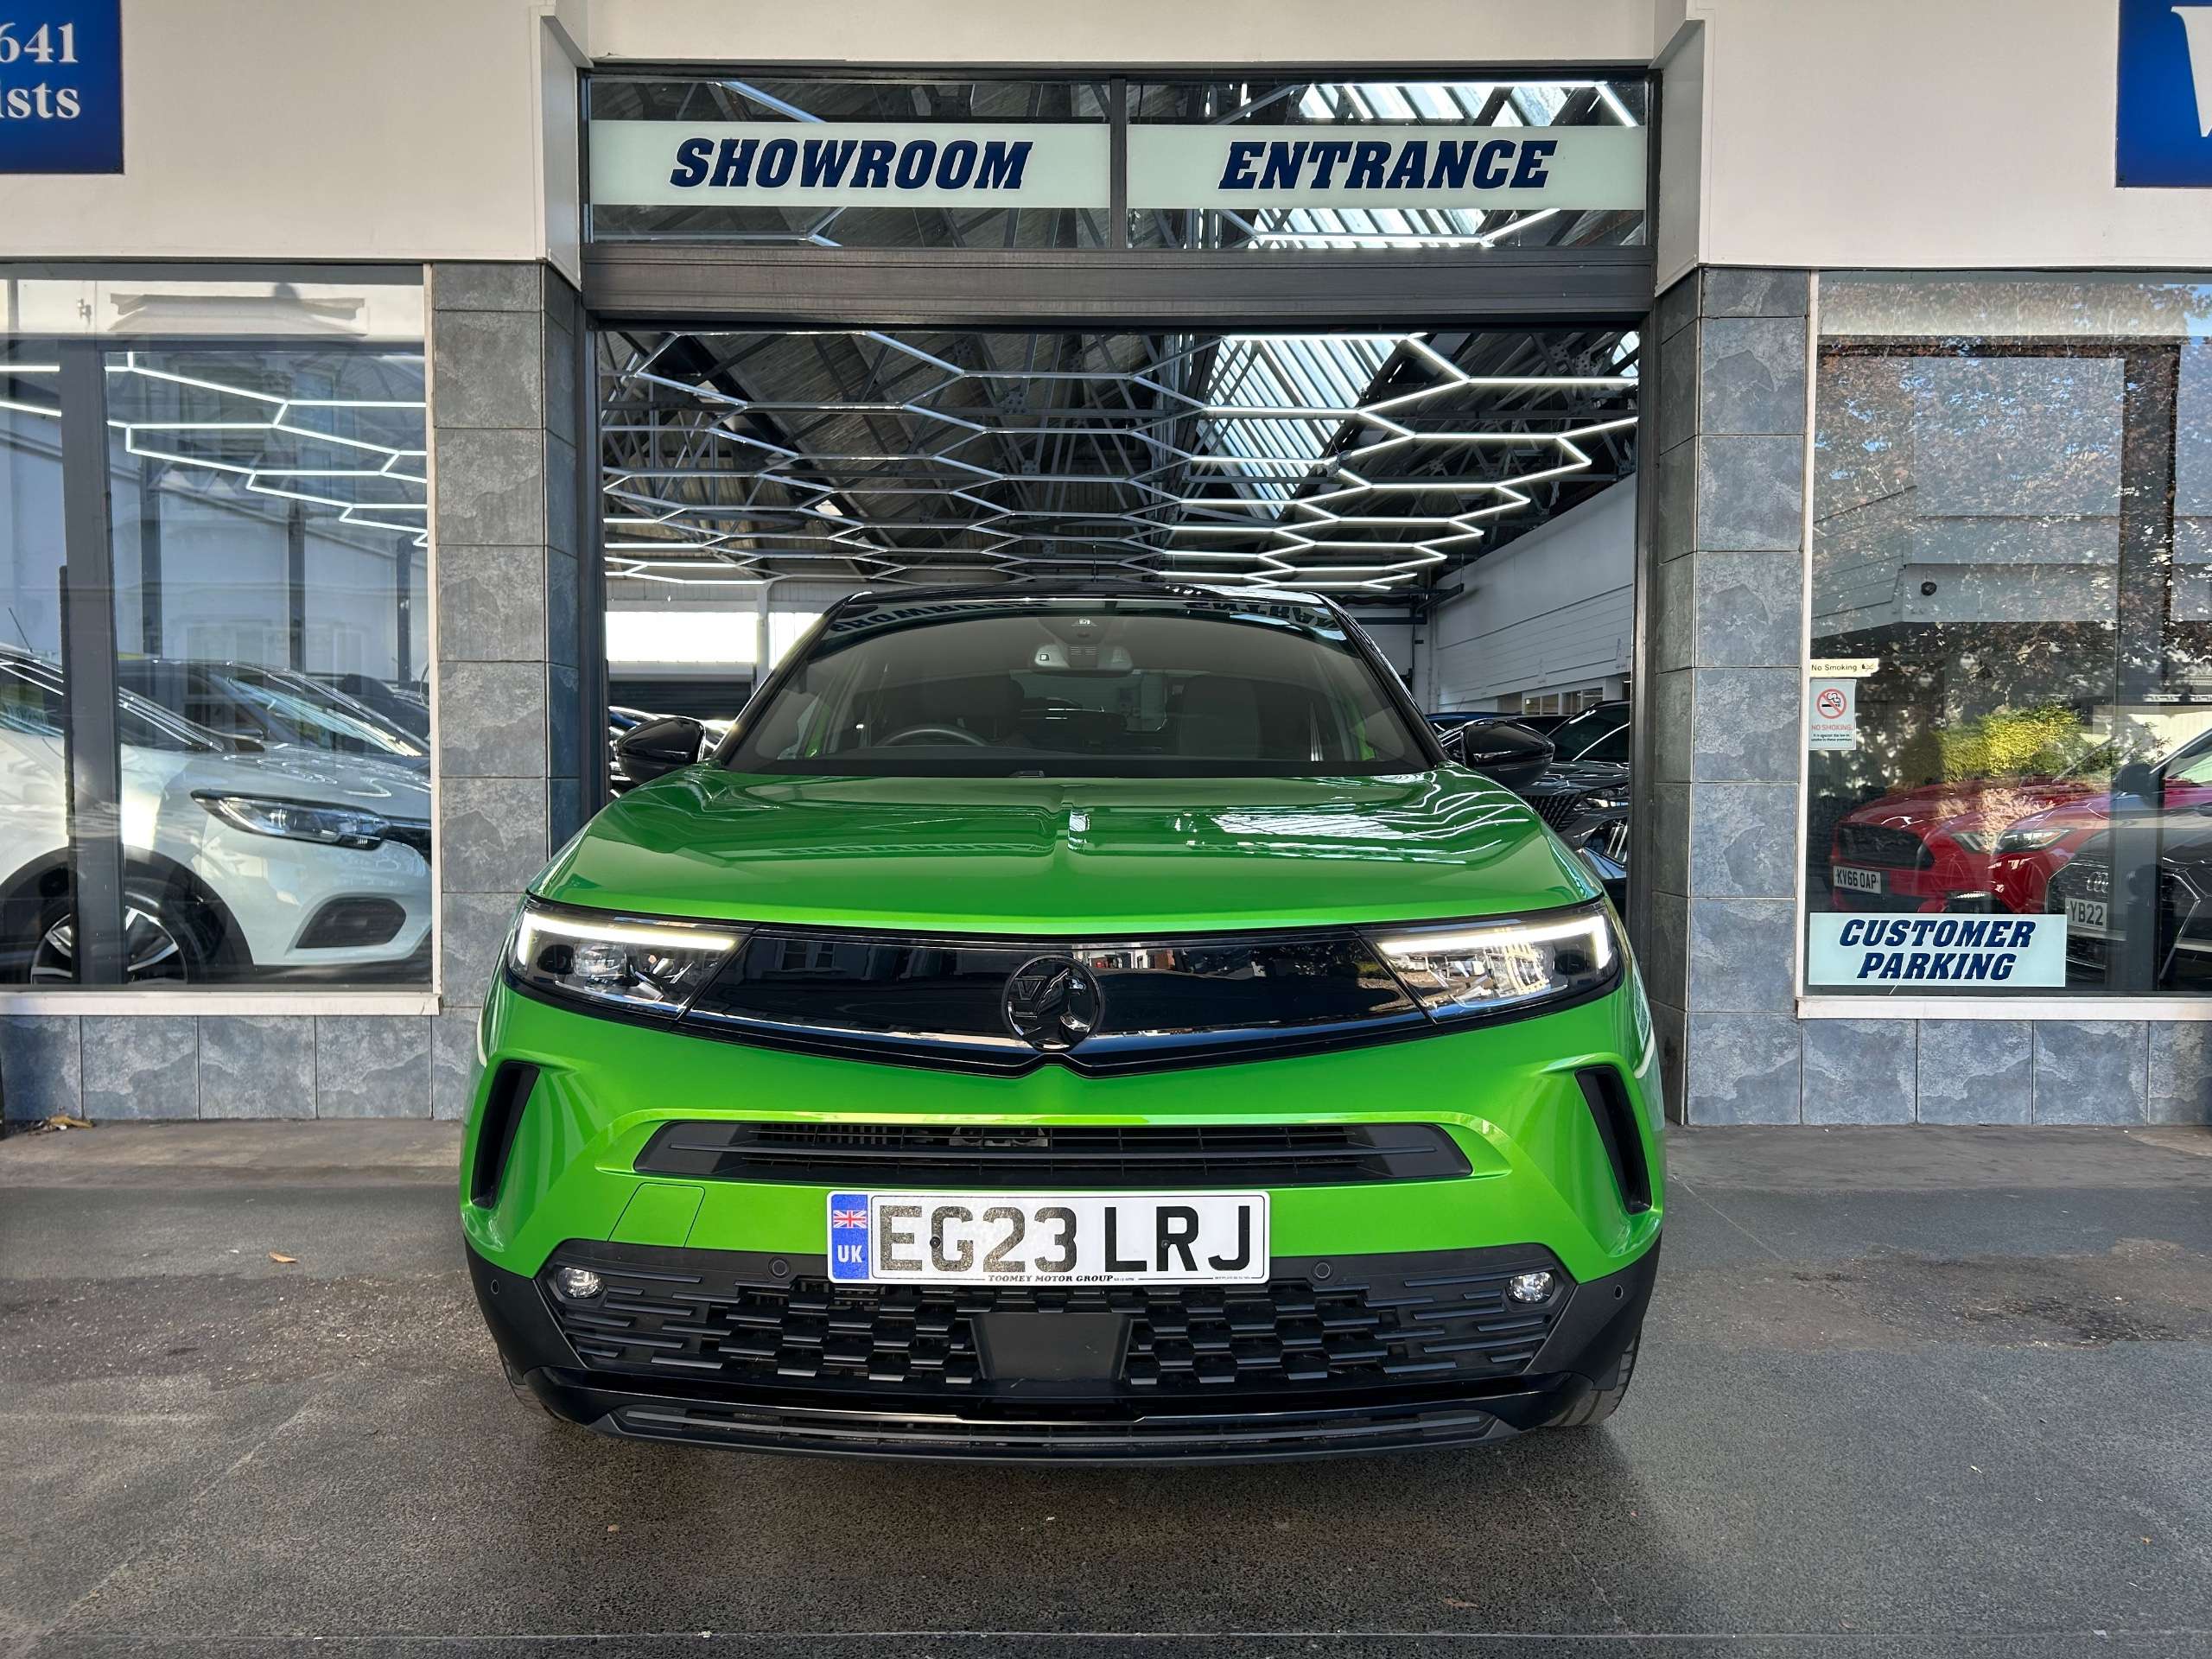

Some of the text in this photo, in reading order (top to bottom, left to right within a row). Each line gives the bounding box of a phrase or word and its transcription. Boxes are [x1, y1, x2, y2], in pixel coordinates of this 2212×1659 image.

[0, 22, 79, 63] 641
[670, 137, 1558, 190] SHOWROOM ENTRANCE
[1825, 664, 1858, 672] Smoking
[1837, 868, 1858, 887] KV66
[2070, 900, 2104, 926] YB22
[1839, 918, 2037, 948] CUSTOMER
[1856, 952, 2018, 981] PARKING
[837, 1244, 863, 1263] UK
[880, 1205, 1250, 1273] EG23 LRJ
